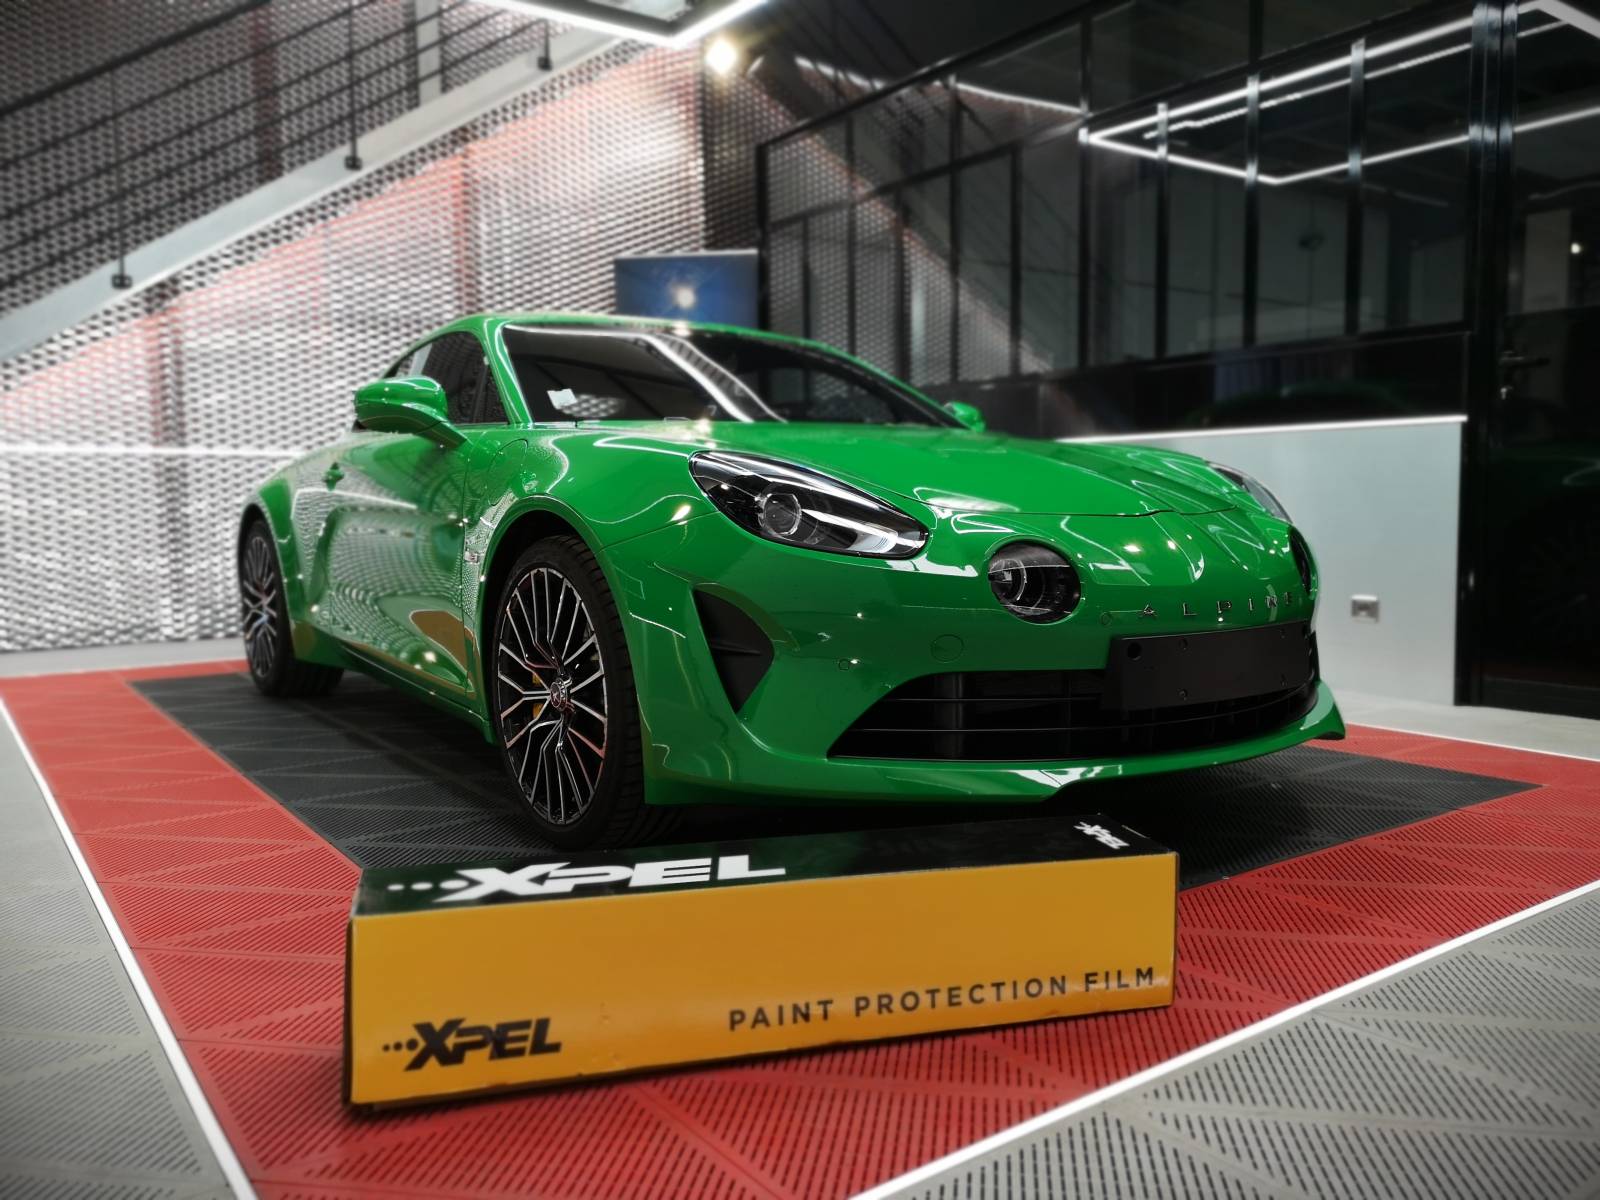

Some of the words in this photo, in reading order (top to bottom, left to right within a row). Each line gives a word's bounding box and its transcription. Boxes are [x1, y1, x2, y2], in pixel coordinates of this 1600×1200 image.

[432, 854, 787, 902] XPEL
[728, 999, 834, 1031] PAINT
[855, 975, 1067, 1017] PROTECTION
[1084, 966, 1154, 993] FILM
[403, 1017, 562, 1072] XPEL
